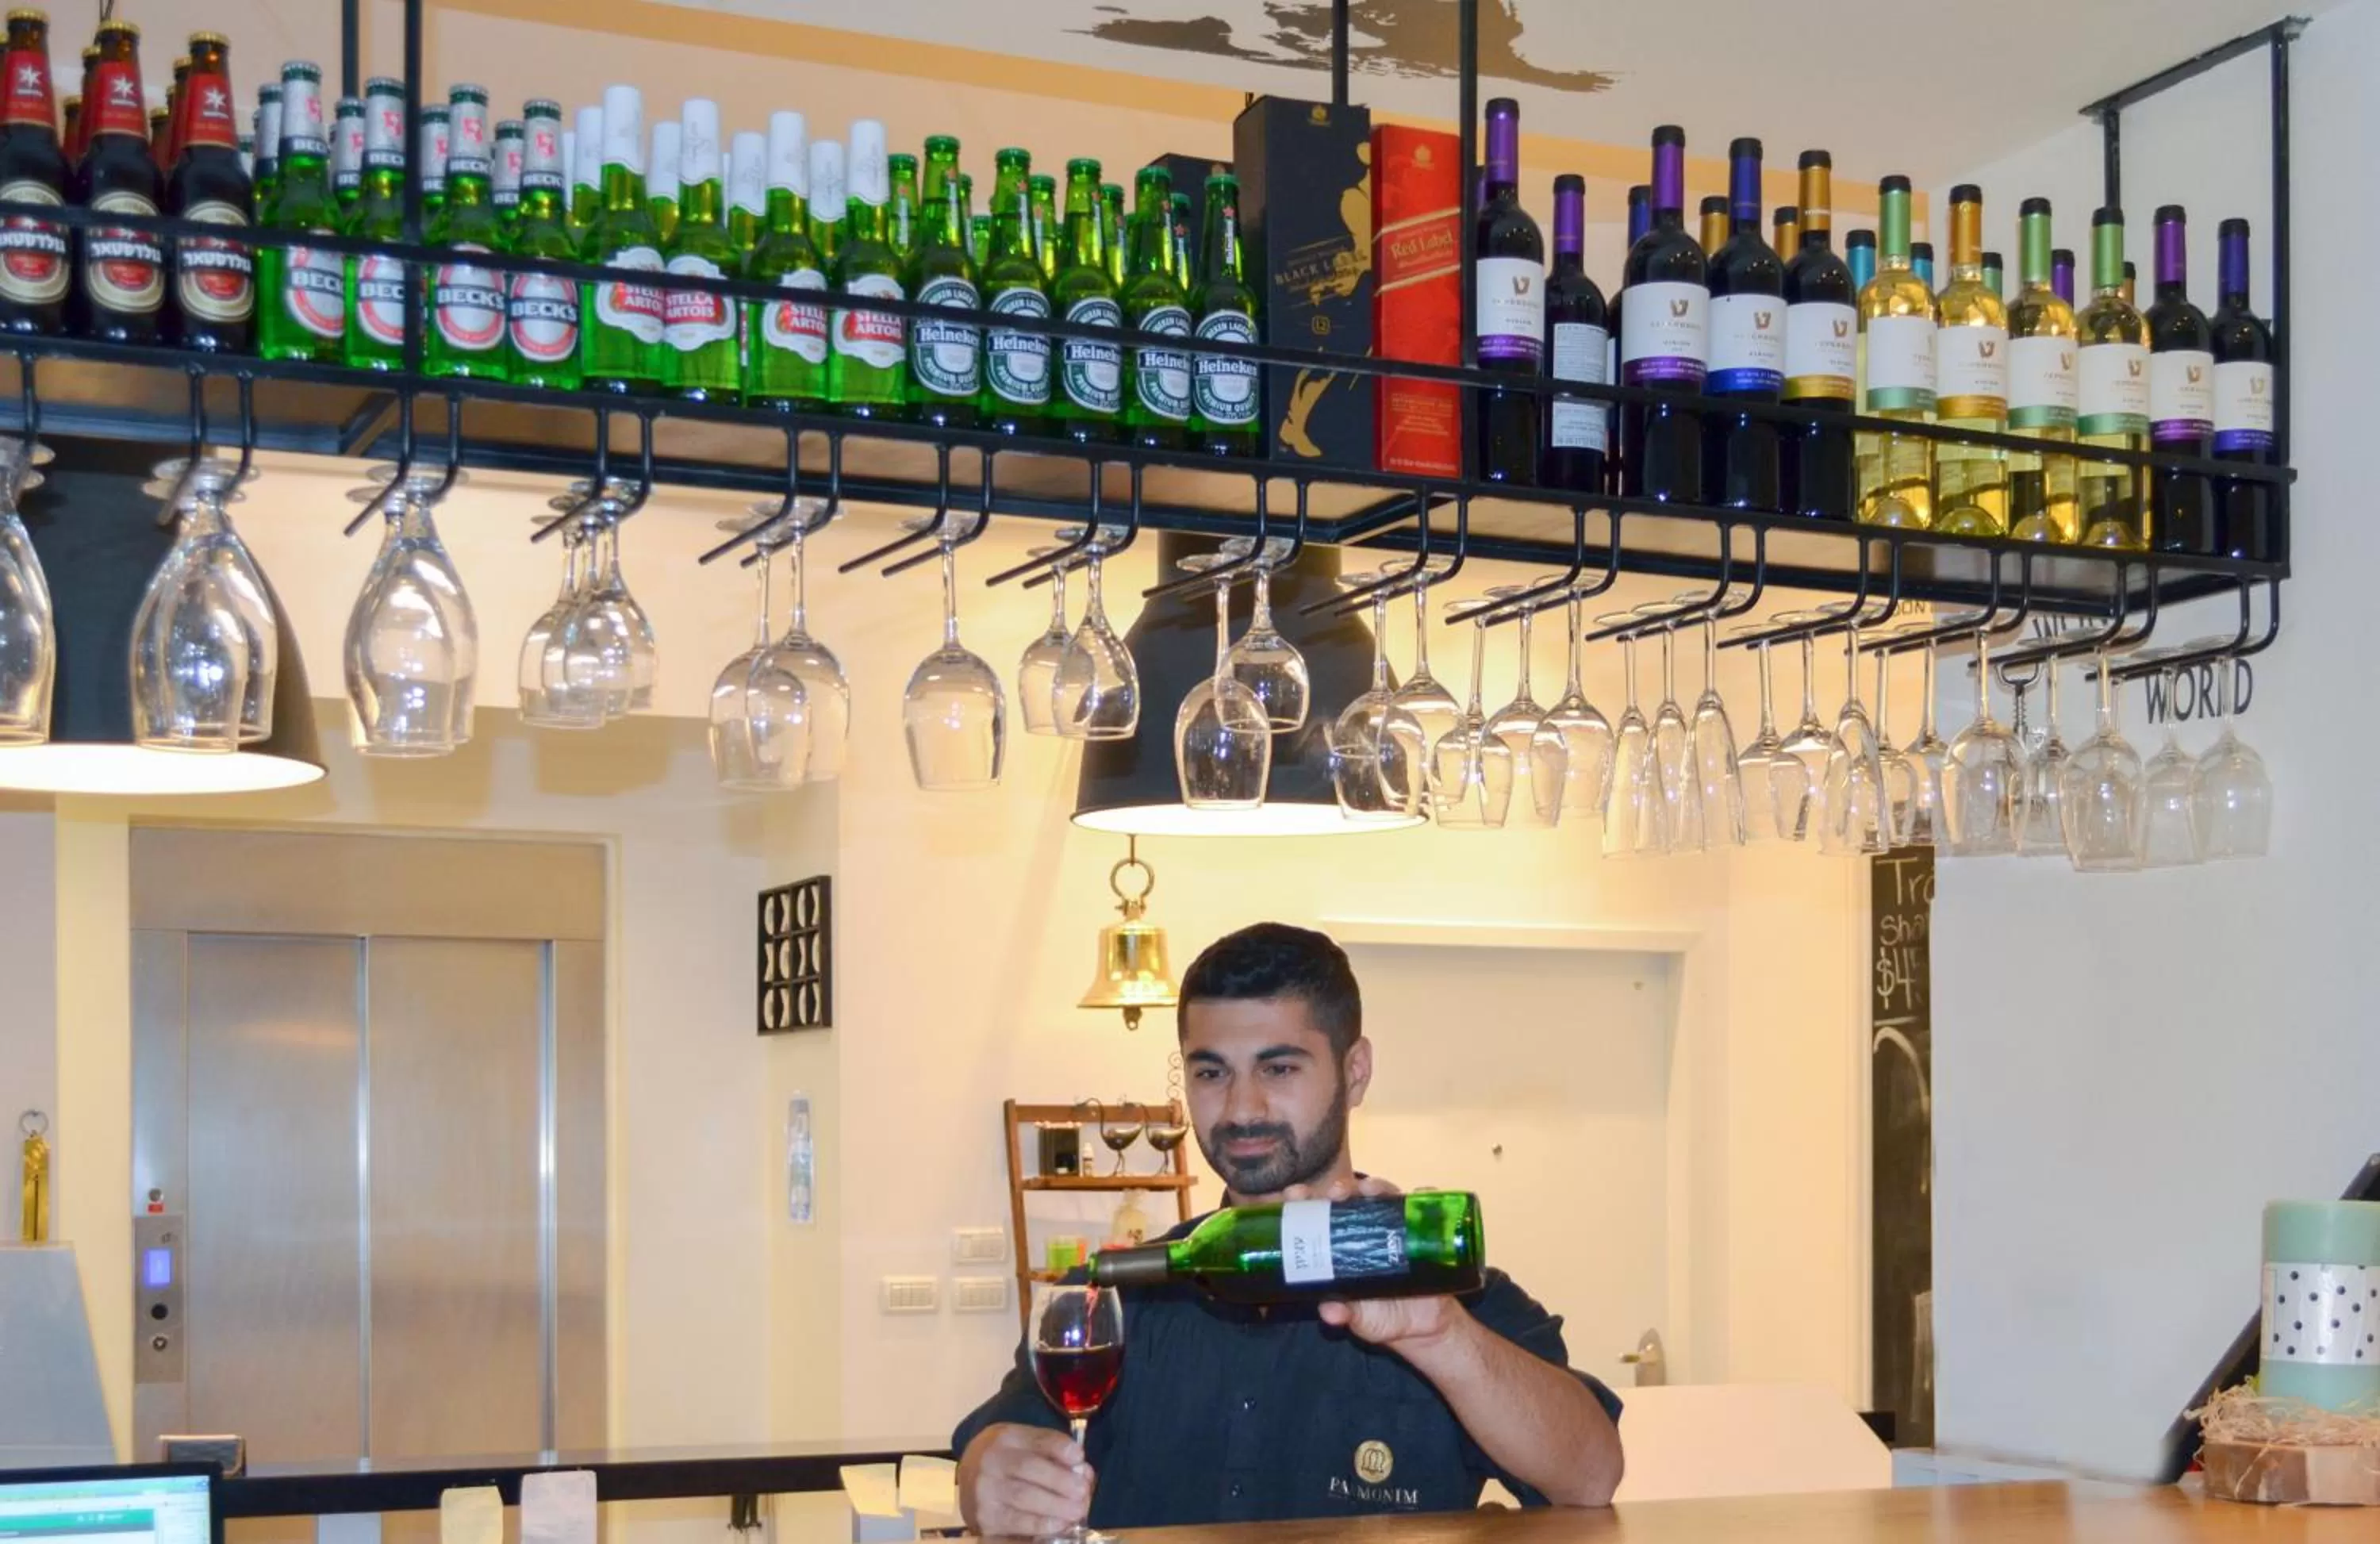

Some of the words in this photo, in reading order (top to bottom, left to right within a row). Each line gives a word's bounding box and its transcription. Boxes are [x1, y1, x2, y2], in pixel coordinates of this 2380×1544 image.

[450, 159, 490, 173] BECK
[523, 174, 564, 188] BECK
[0, 230, 66, 254] גולדסטא
[1392, 239, 1418, 261] Red
[1418, 228, 1454, 252] Label
